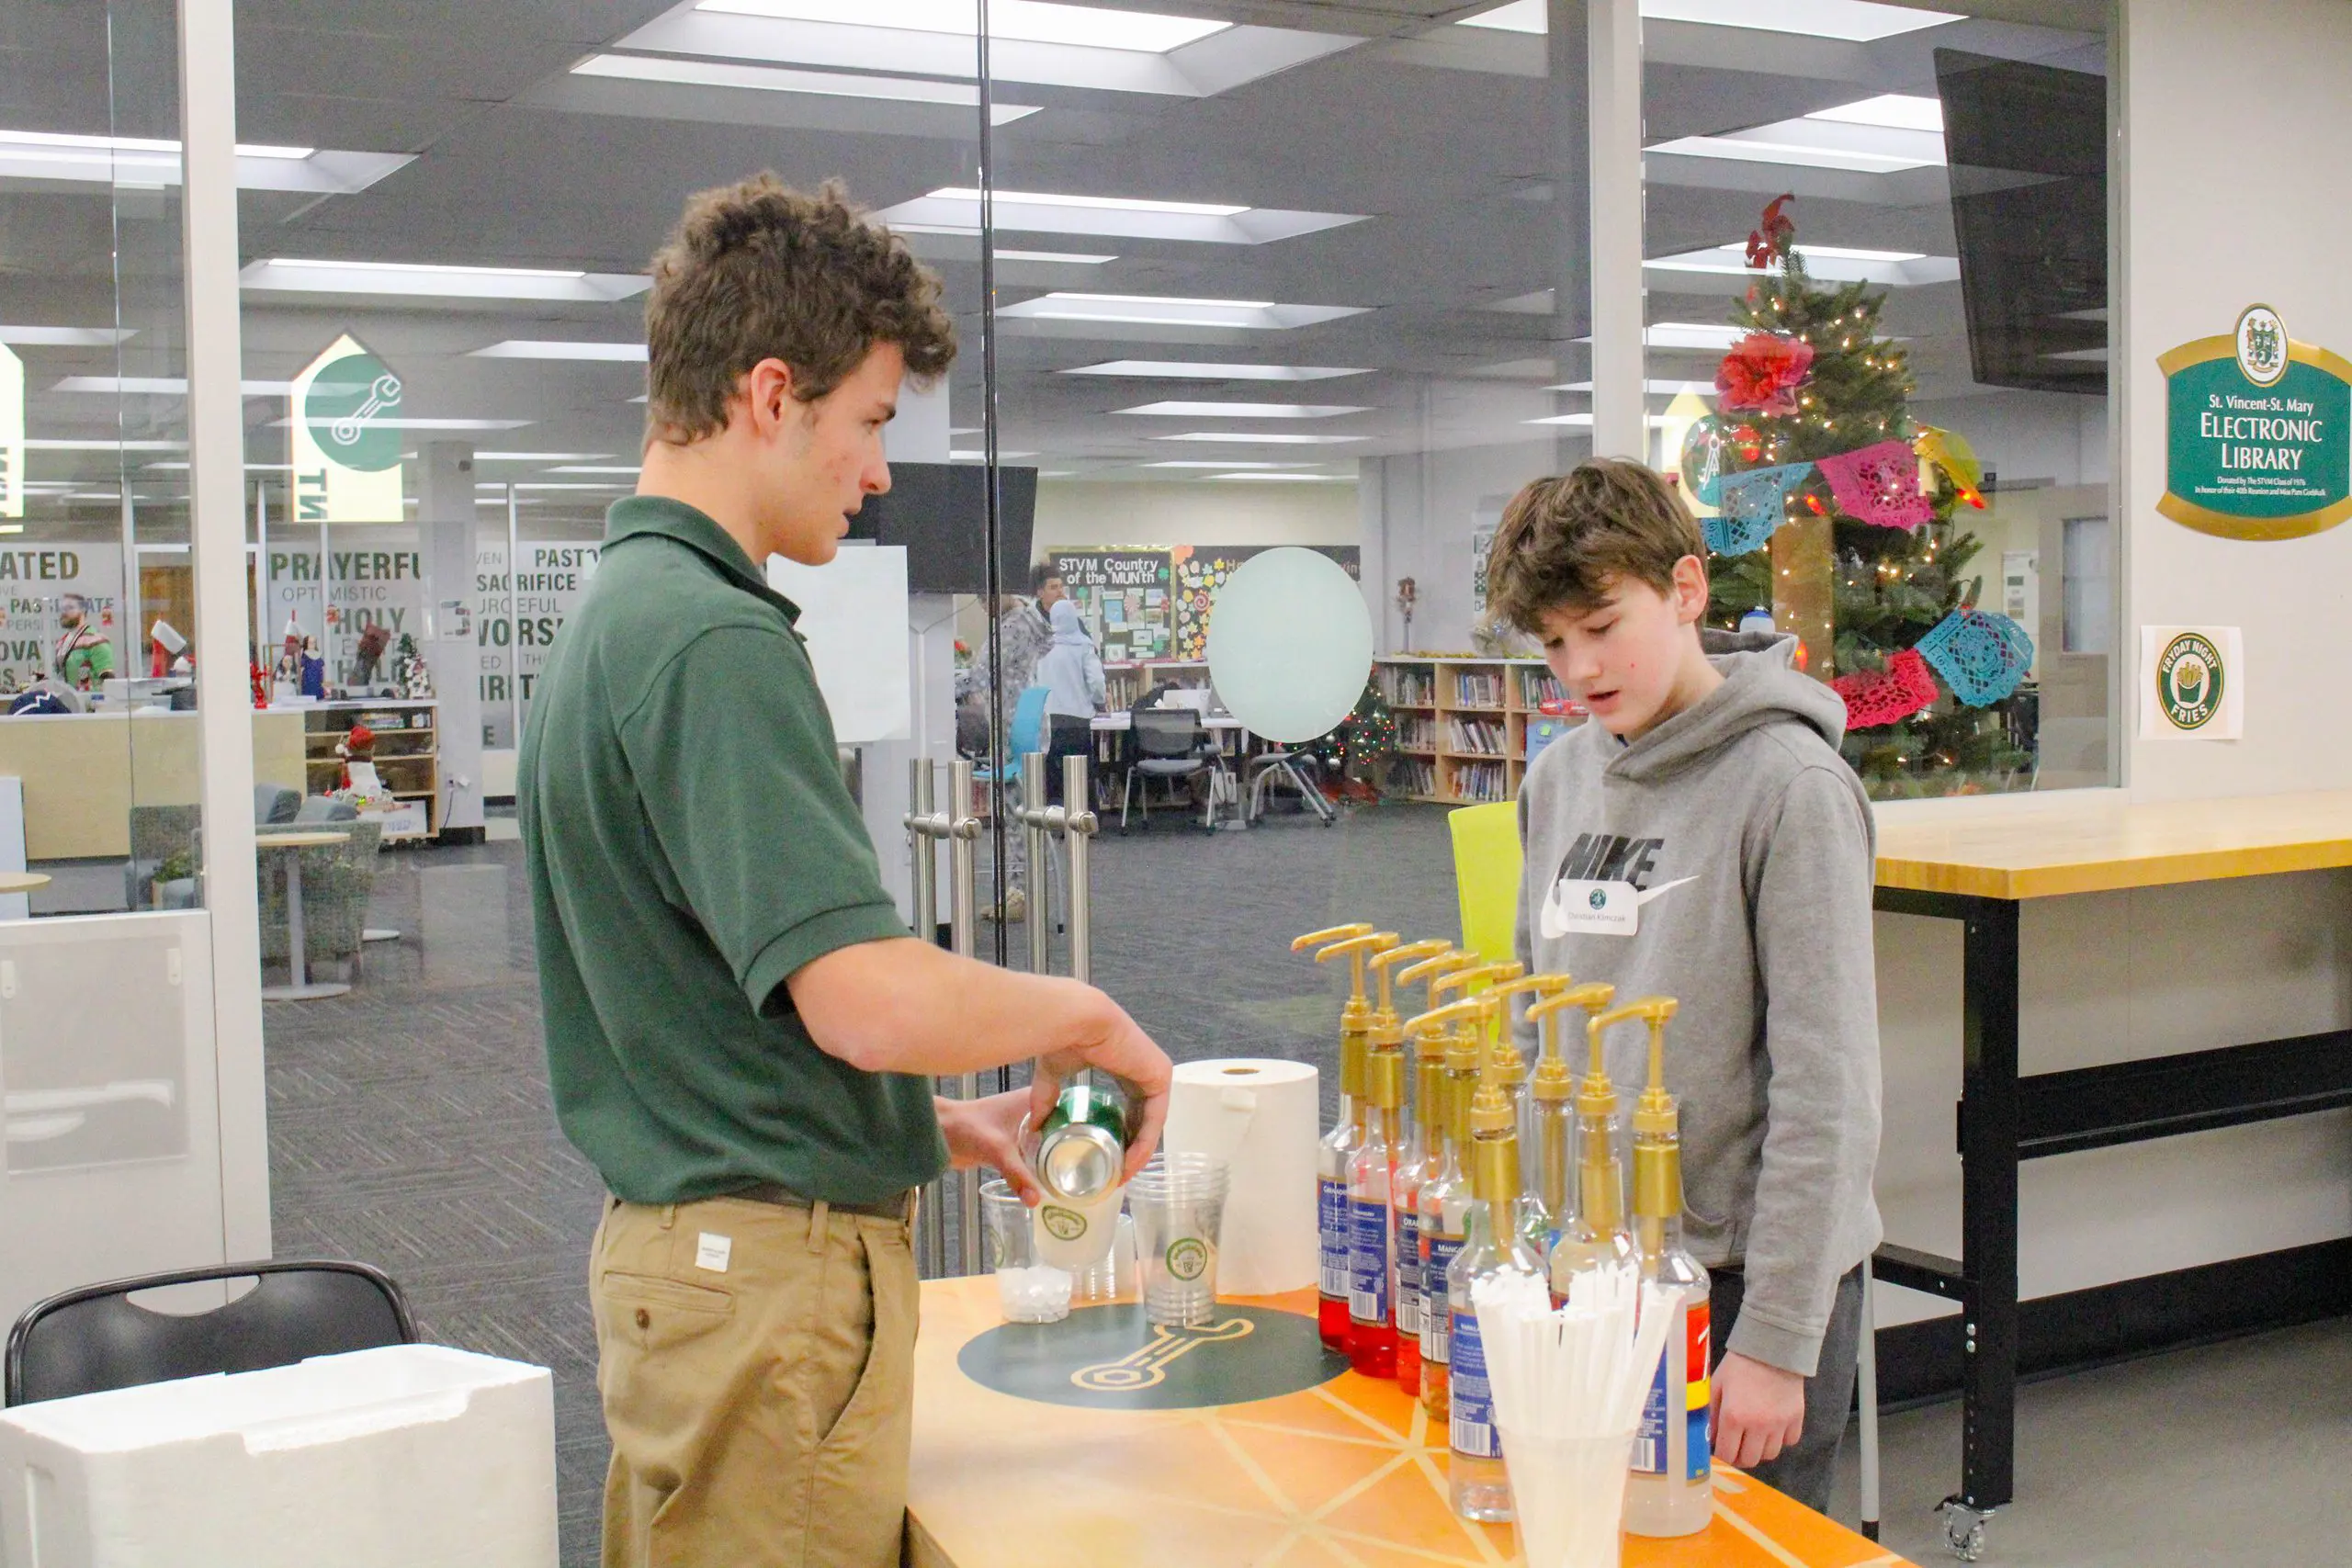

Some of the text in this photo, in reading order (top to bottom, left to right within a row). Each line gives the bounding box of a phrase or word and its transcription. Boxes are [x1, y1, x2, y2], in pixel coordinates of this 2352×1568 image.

[2209, 394, 2314, 417] St. Vincent-St. Mary
[2200, 412, 2323, 442] ELECTRONIC
[2222, 443, 2302, 470] LIBRARY
[1059, 558, 1159, 574] STVM Country
[476, 573, 577, 592] SACRIFICE
[1067, 571, 1080, 585] of
[1086, 571, 1106, 585] the
[282, 586, 388, 603] OPTMISTIC
[2162, 640, 2218, 673] FRYDAY NIGHT
[2170, 704, 2208, 723] FRIES
[1556, 832, 1665, 891] NIKE
